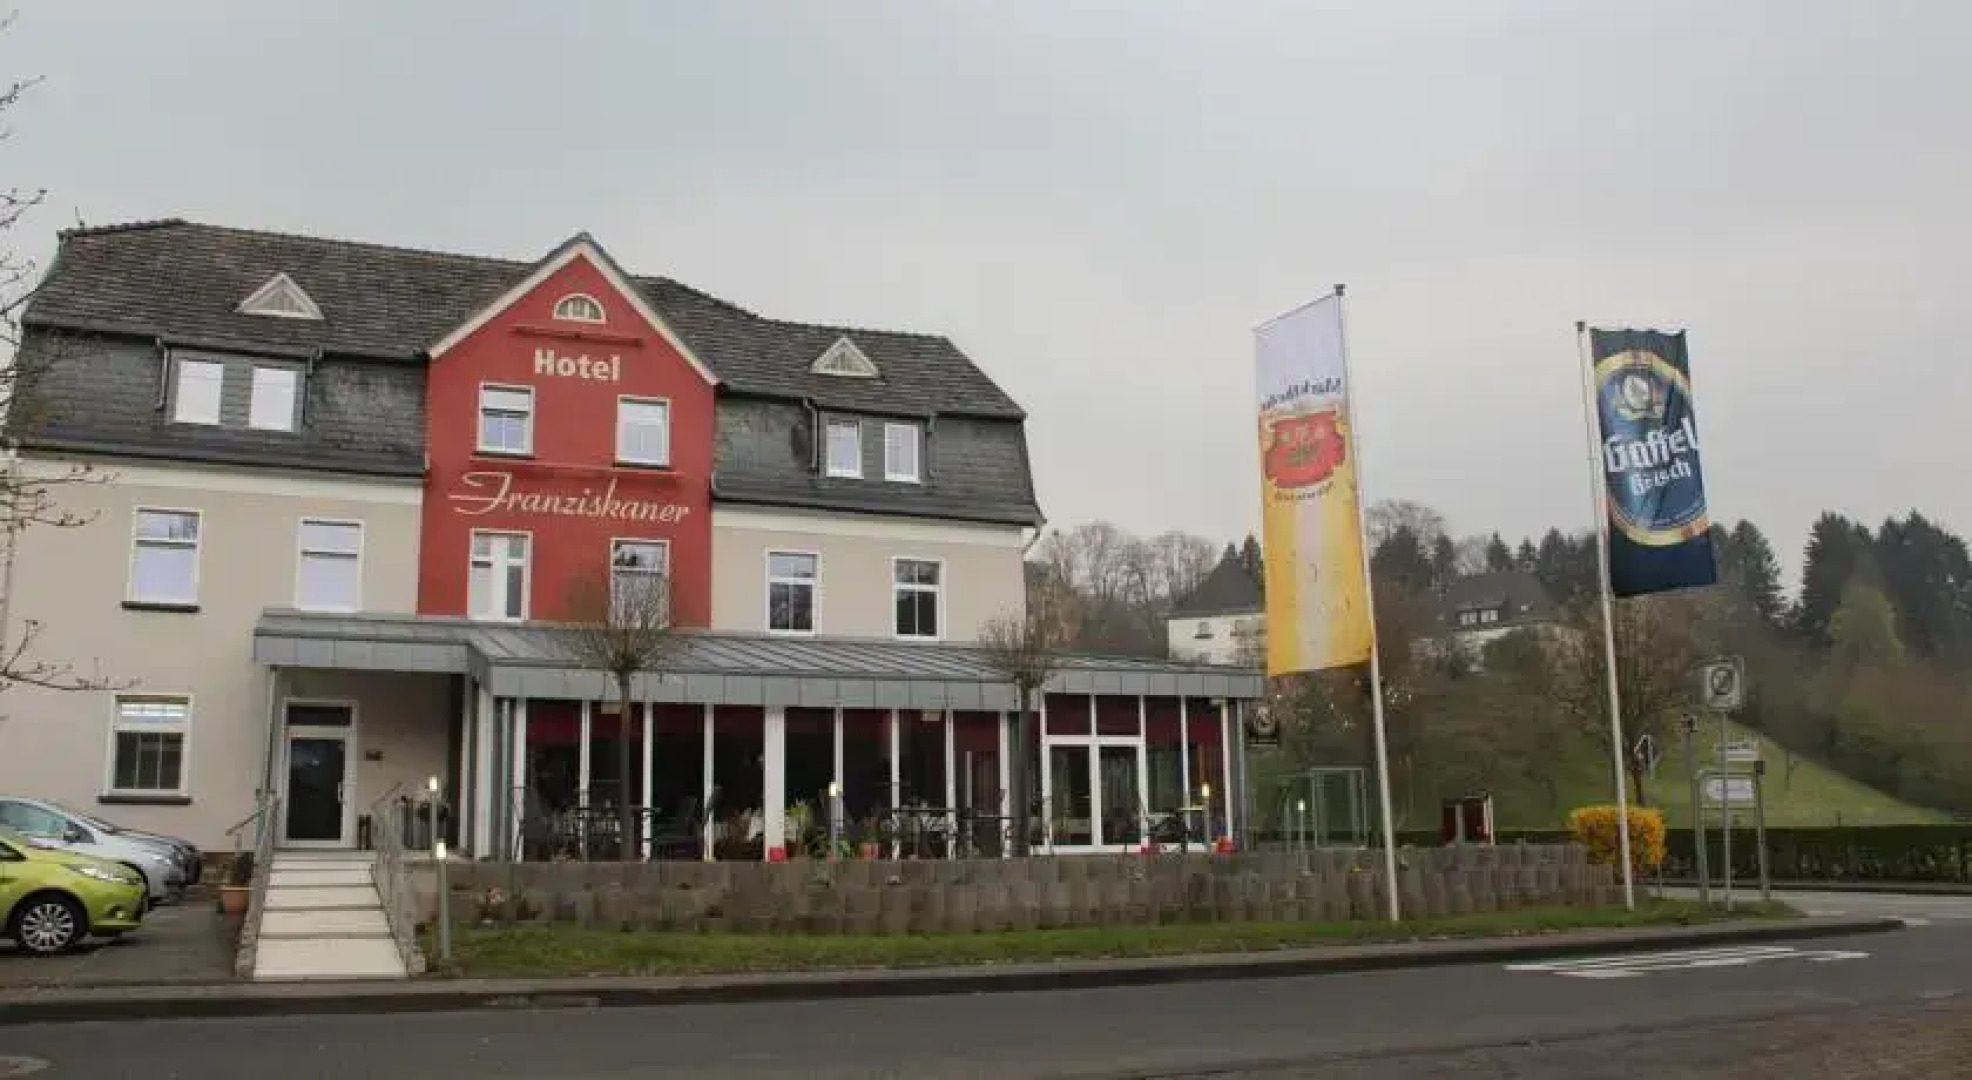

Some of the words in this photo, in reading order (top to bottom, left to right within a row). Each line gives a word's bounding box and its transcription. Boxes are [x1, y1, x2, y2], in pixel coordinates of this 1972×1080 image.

[534, 349, 621, 382] Hotel
[1605, 418, 1700, 472] Gaffel
[449, 471, 690, 523] Franziskaner
